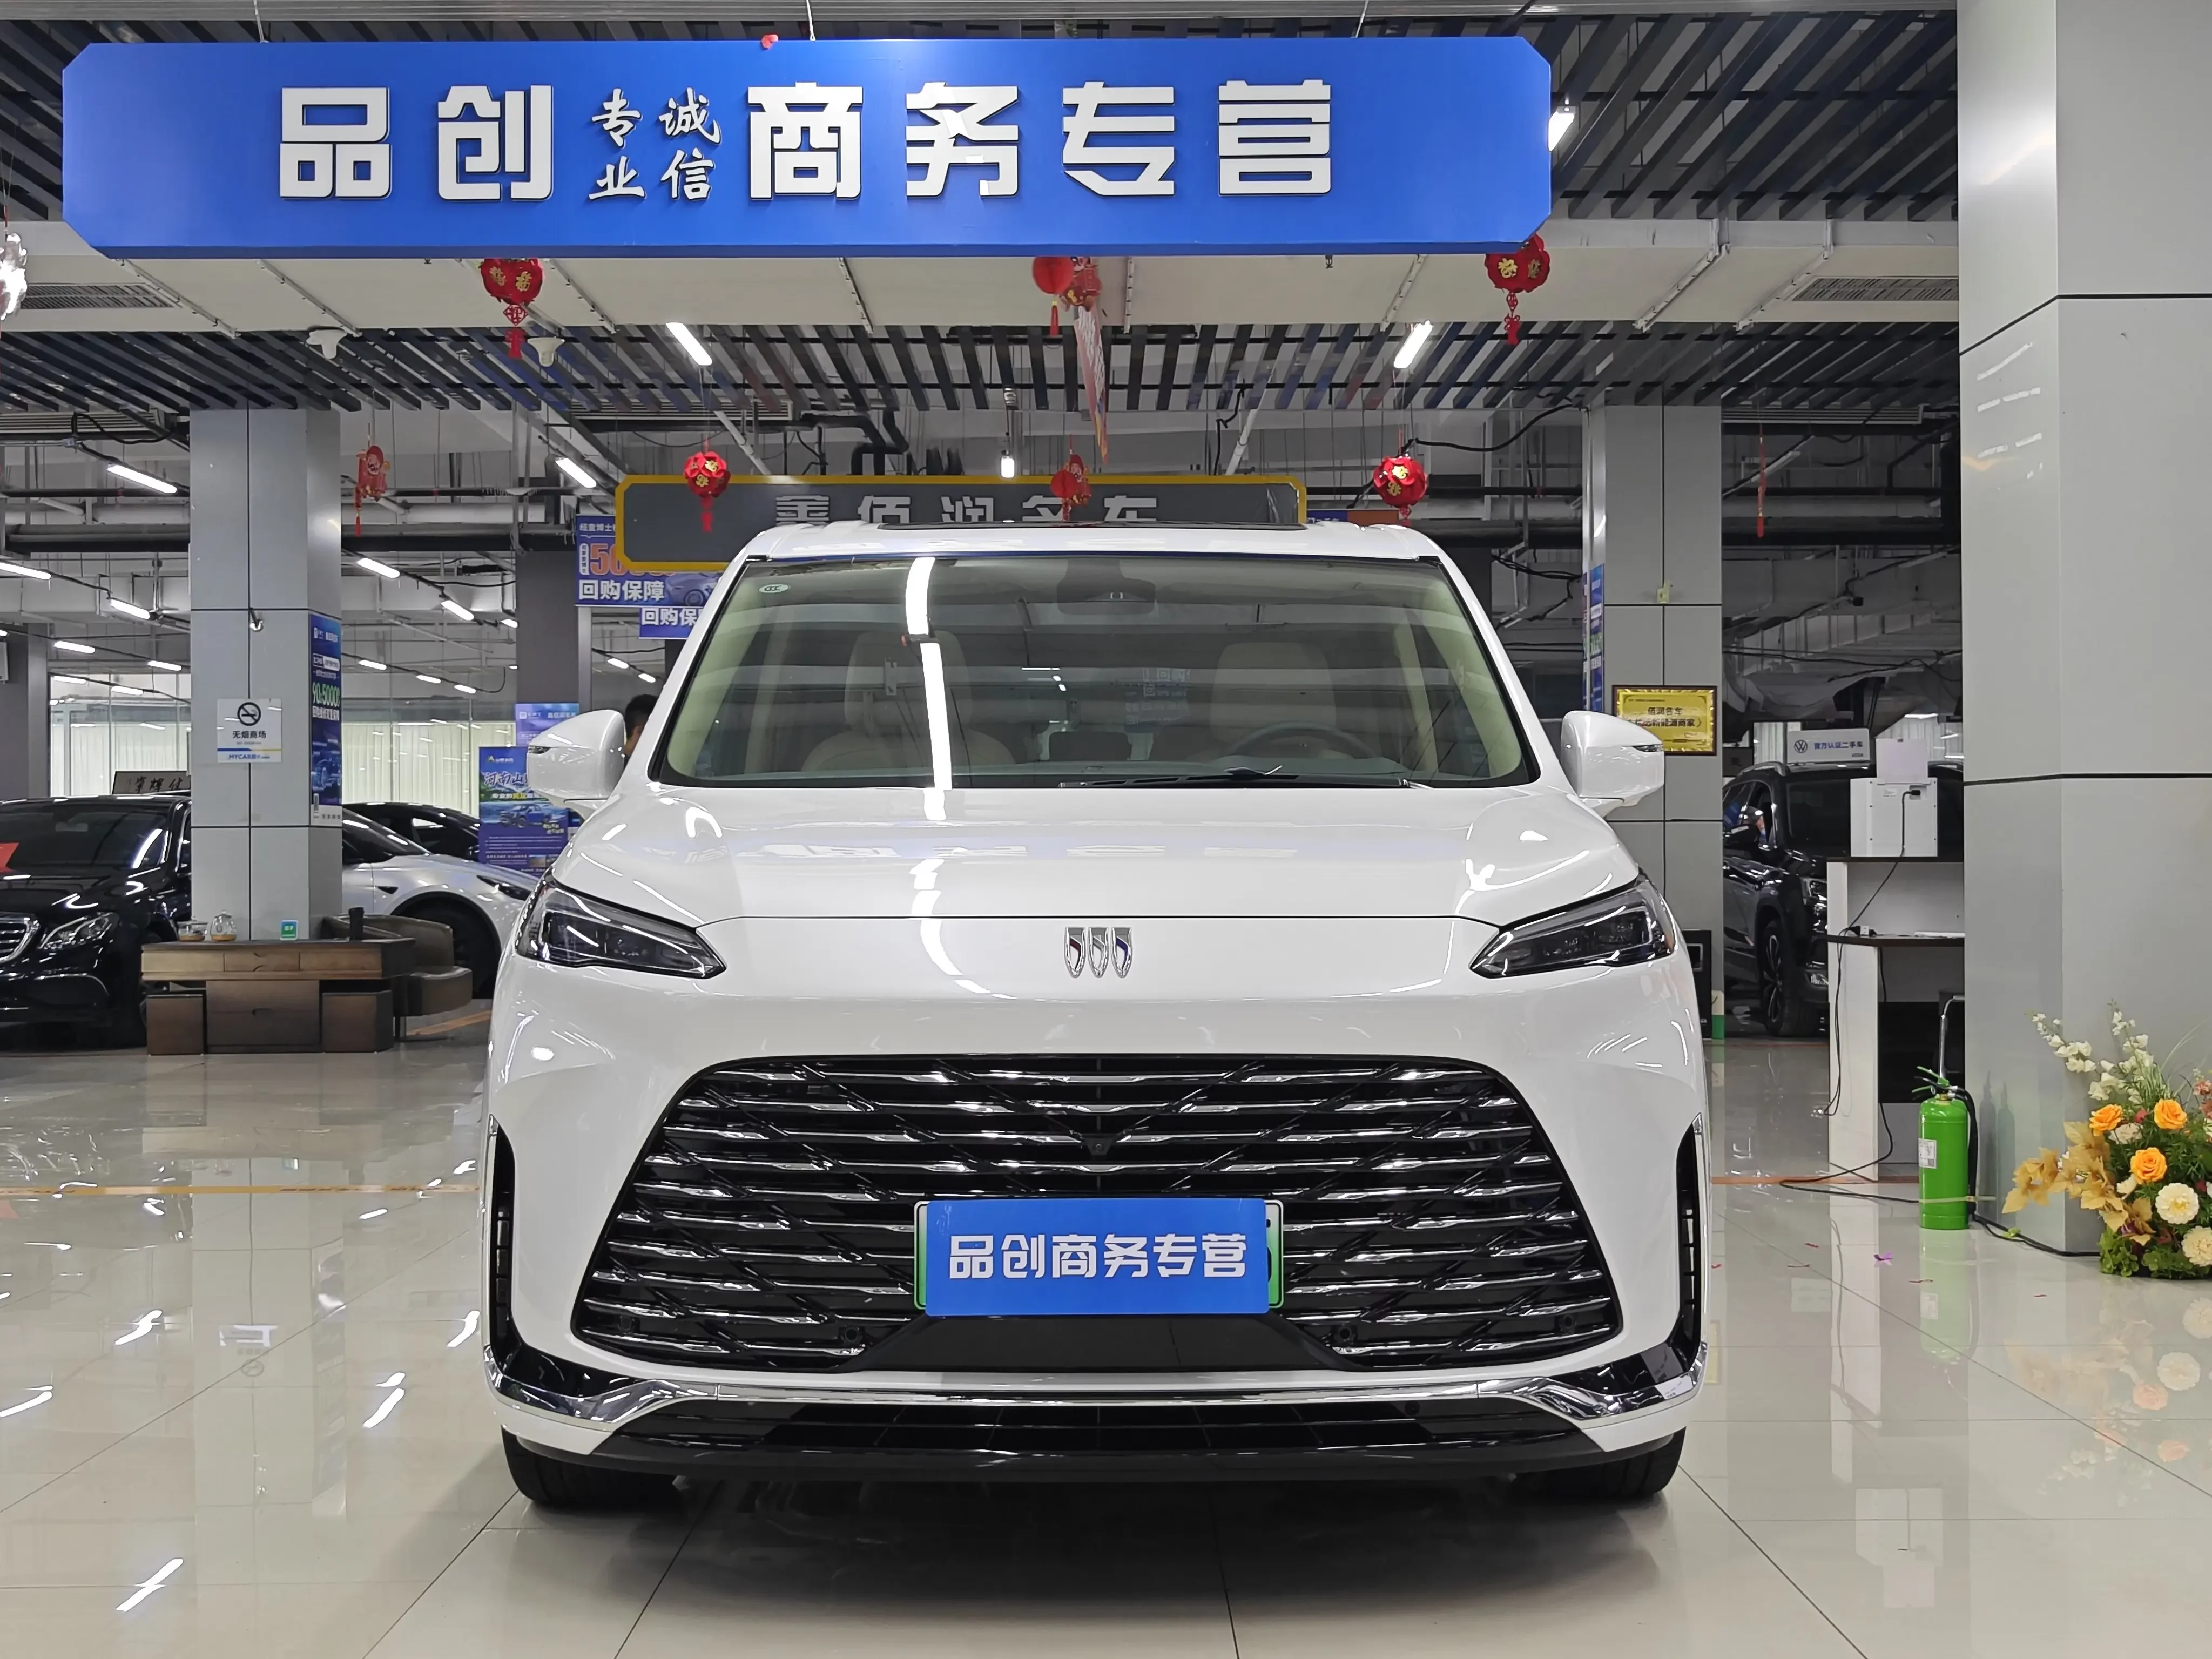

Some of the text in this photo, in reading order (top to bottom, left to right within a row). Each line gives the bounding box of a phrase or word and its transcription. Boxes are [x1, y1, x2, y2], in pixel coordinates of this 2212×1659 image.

[280, 80, 1331, 200] 品创 商务专营
[579, 579, 665, 601] 回购保障
[642, 608, 704, 626] 回购保
[232, 730, 267, 739] 无烟商场
[1814, 741, 1863, 750] 官方认证二手车
[483, 771, 529, 787] 河南山
[949, 1233, 1246, 1279] 品创商务专营
